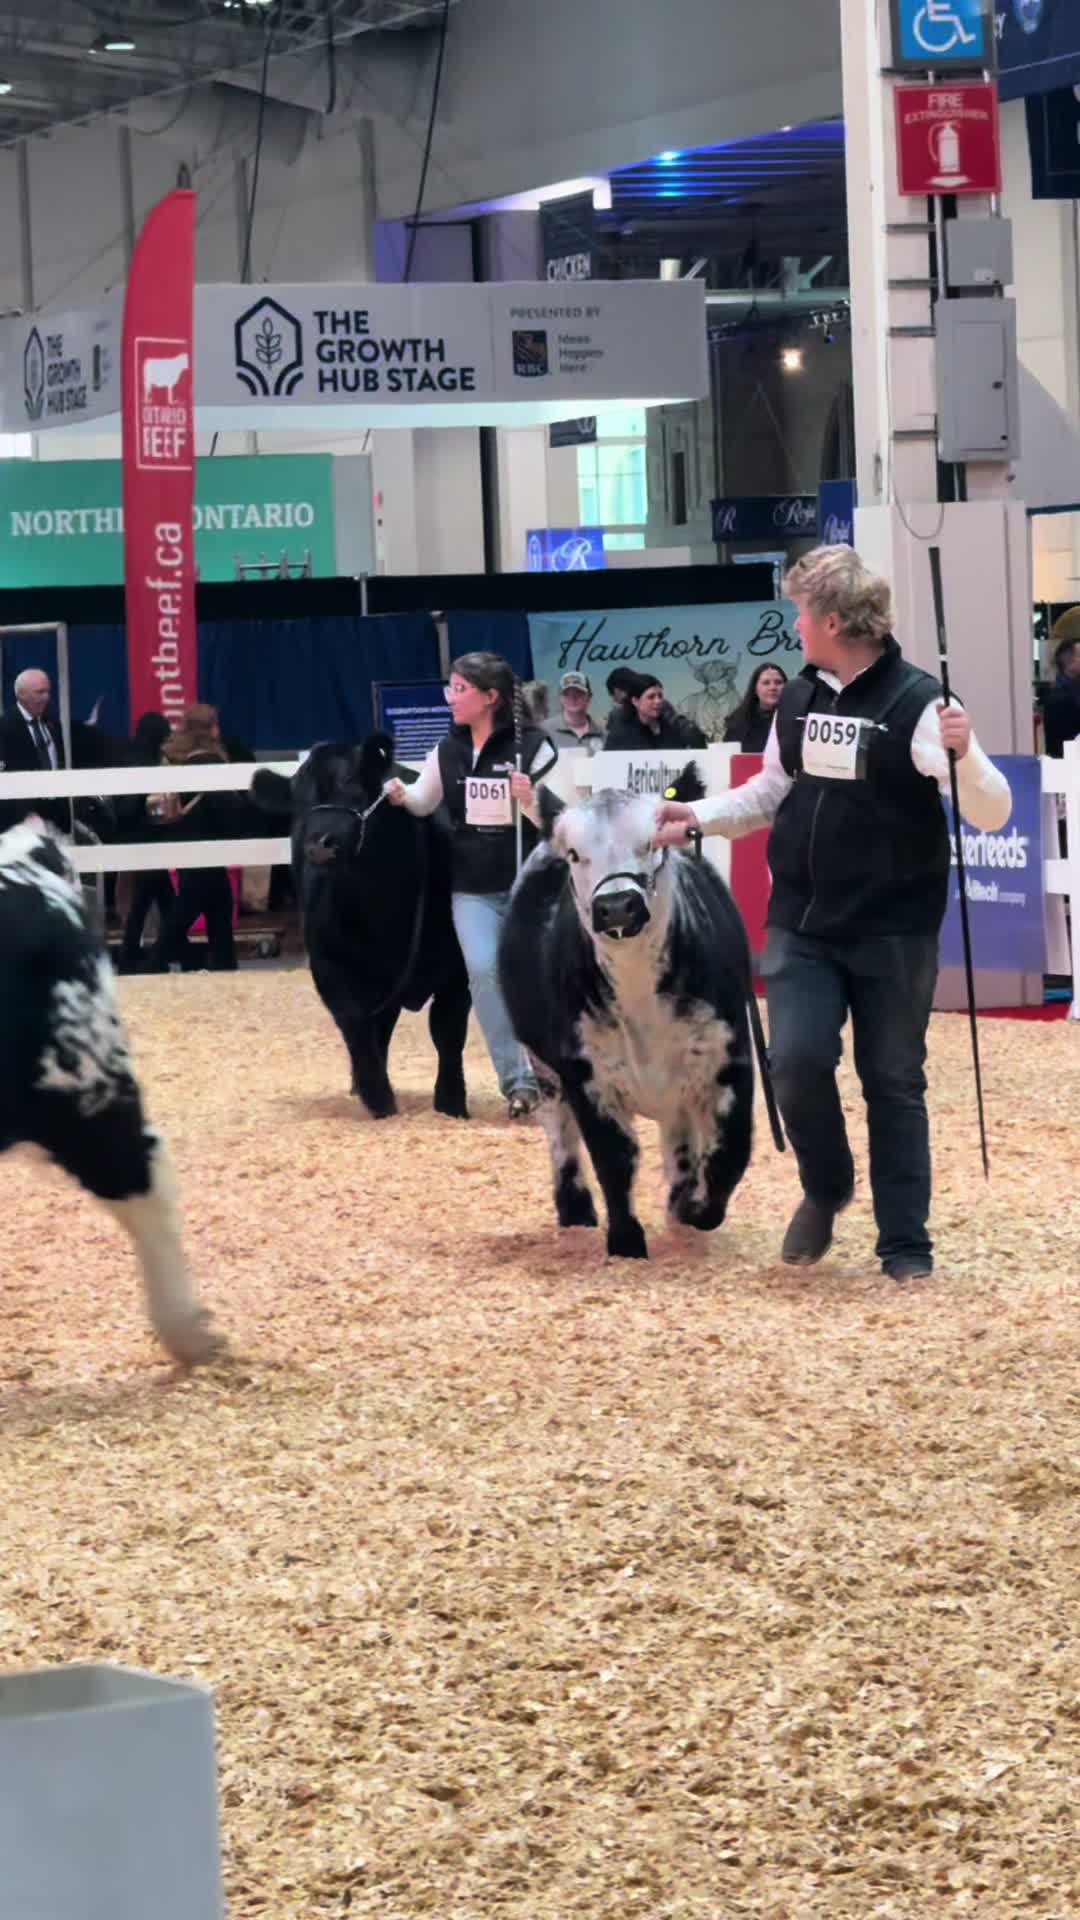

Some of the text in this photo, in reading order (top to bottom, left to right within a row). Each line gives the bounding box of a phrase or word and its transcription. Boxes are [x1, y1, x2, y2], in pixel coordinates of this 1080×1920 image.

[927, 92, 964, 111] FIRE
[313, 310, 370, 335] THE
[316, 338, 445, 364] GROWTH
[318, 367, 476, 393] HUB STAGE
[557, 617, 729, 671] Hawthorn
[808, 719, 857, 746] 0059
[470, 782, 506, 800] 0061
